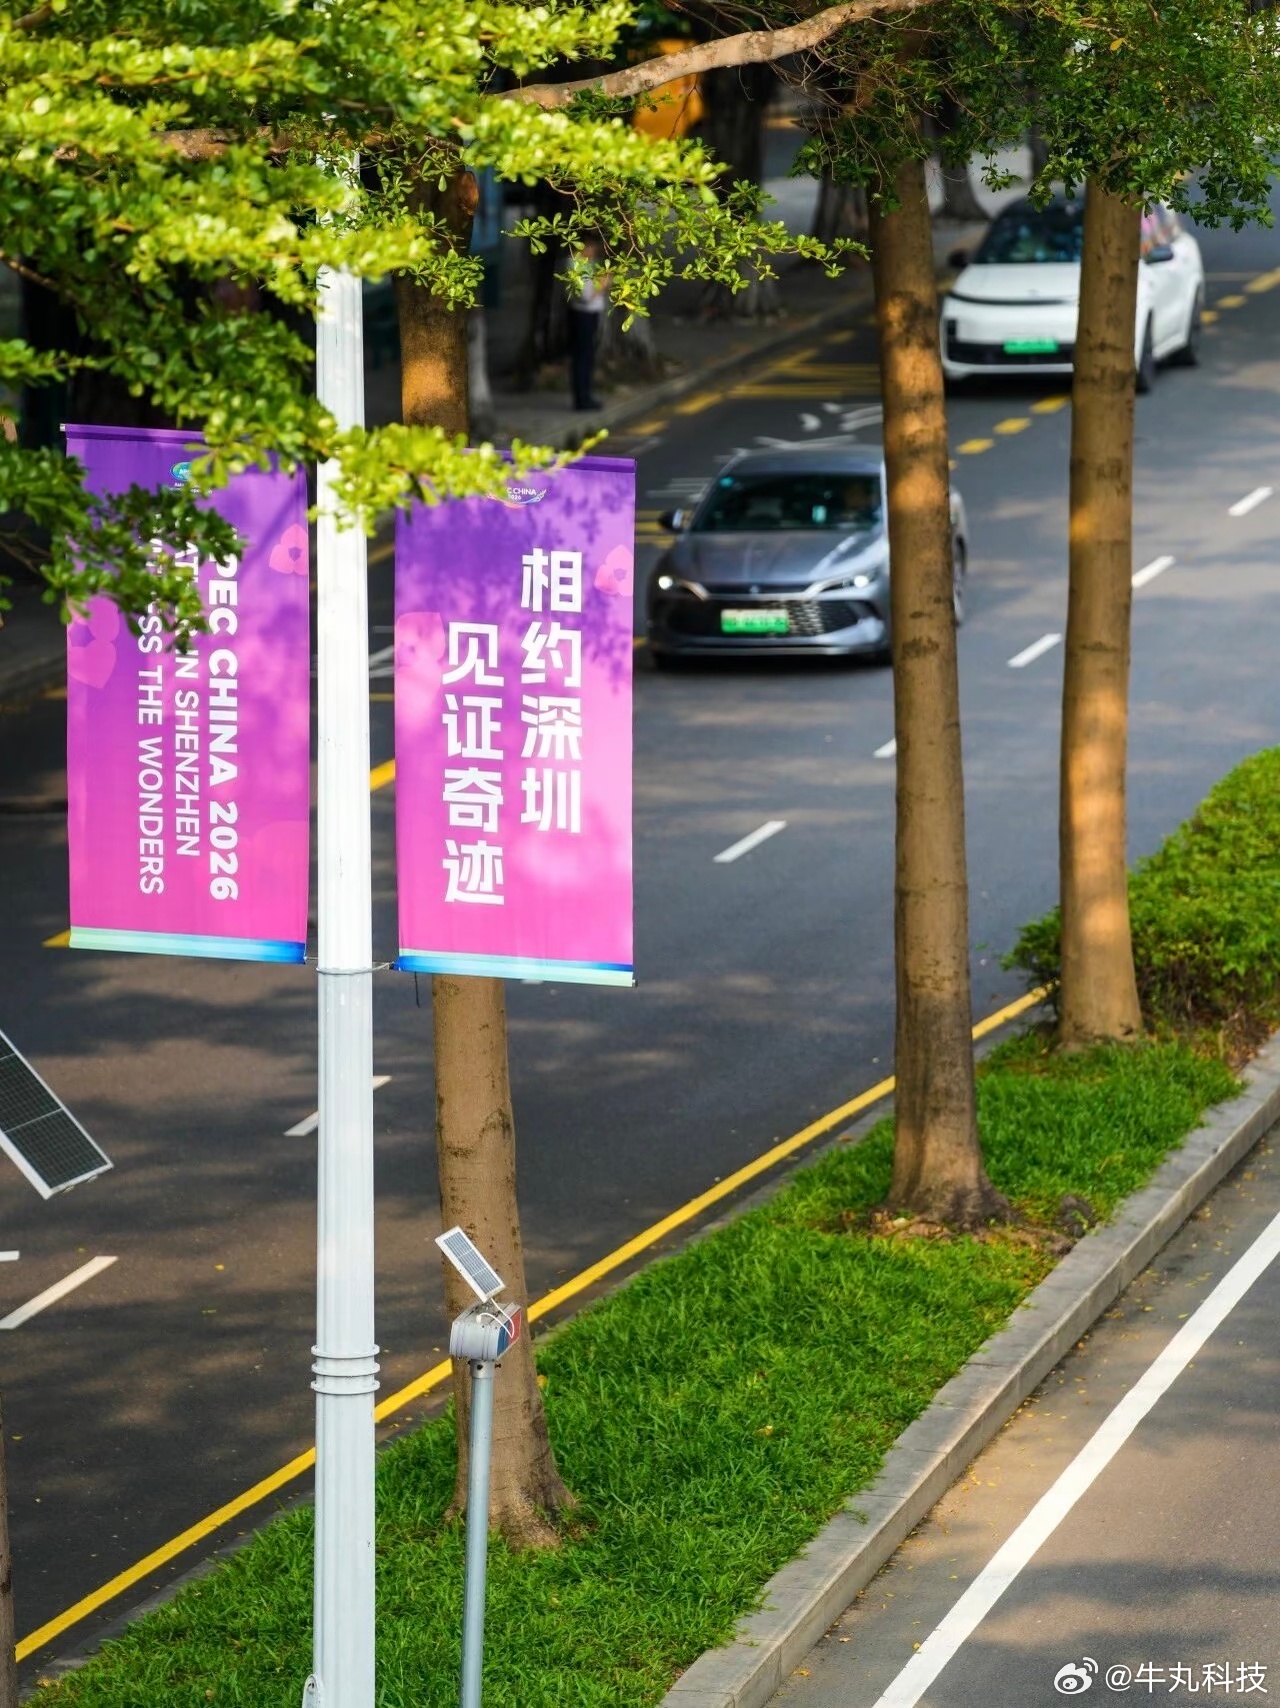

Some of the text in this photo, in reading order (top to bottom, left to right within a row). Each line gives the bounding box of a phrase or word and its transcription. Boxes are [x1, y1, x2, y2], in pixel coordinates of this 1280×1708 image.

[512, 487, 537, 495] CHINA
[138, 665, 163, 725] THE
[175, 690, 200, 857] SHENZHEN
[208, 528, 239, 901] PEC CHINA 2026
[441, 621, 505, 906] 见证奇迹
[520, 547, 583, 834] 相约深圳
[138, 736, 165, 895] WONDERS
